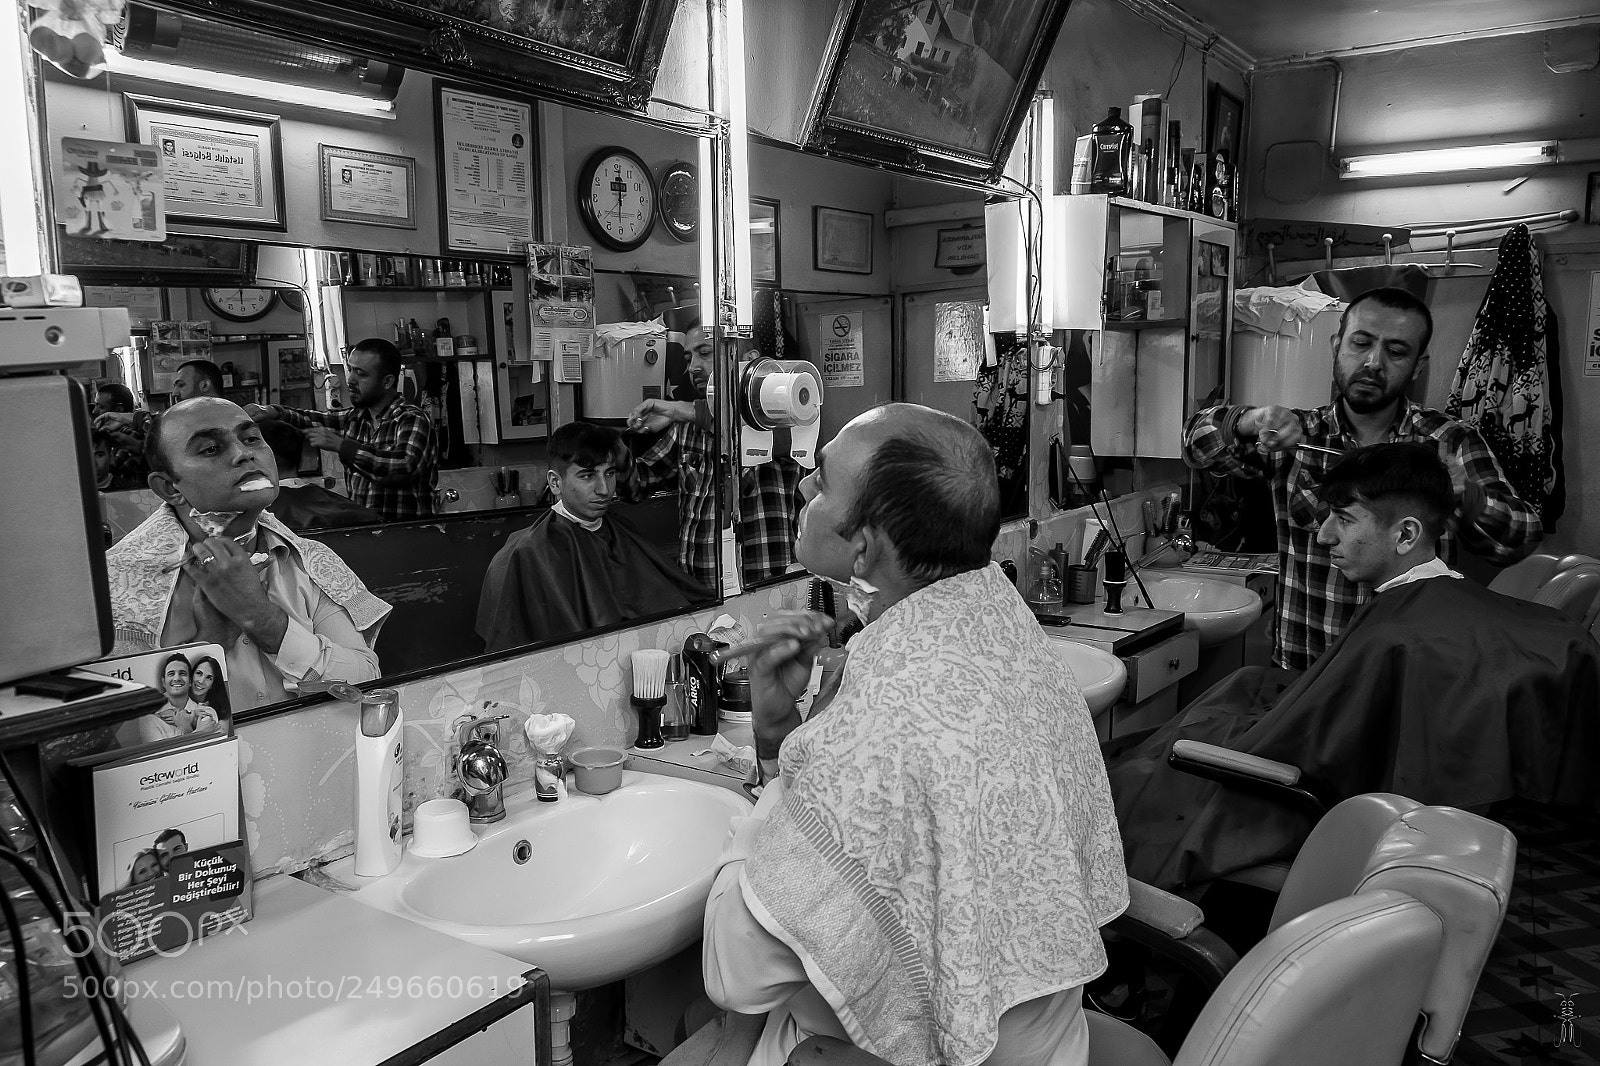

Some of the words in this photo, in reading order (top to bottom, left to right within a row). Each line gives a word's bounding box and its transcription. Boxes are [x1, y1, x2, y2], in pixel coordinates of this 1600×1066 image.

[824, 351, 860, 362] SİGARA
[690, 676, 698, 707] ARKO
[139, 762, 200, 786] esteworld
[194, 856, 224, 869] Küçük
[178, 873, 192, 882] Bir
[195, 864, 237, 878] Dokunuş
[188, 880, 205, 890] Her
[207, 874, 227, 886] Şeyi
[172, 881, 240, 903] Değiştirebilir!
